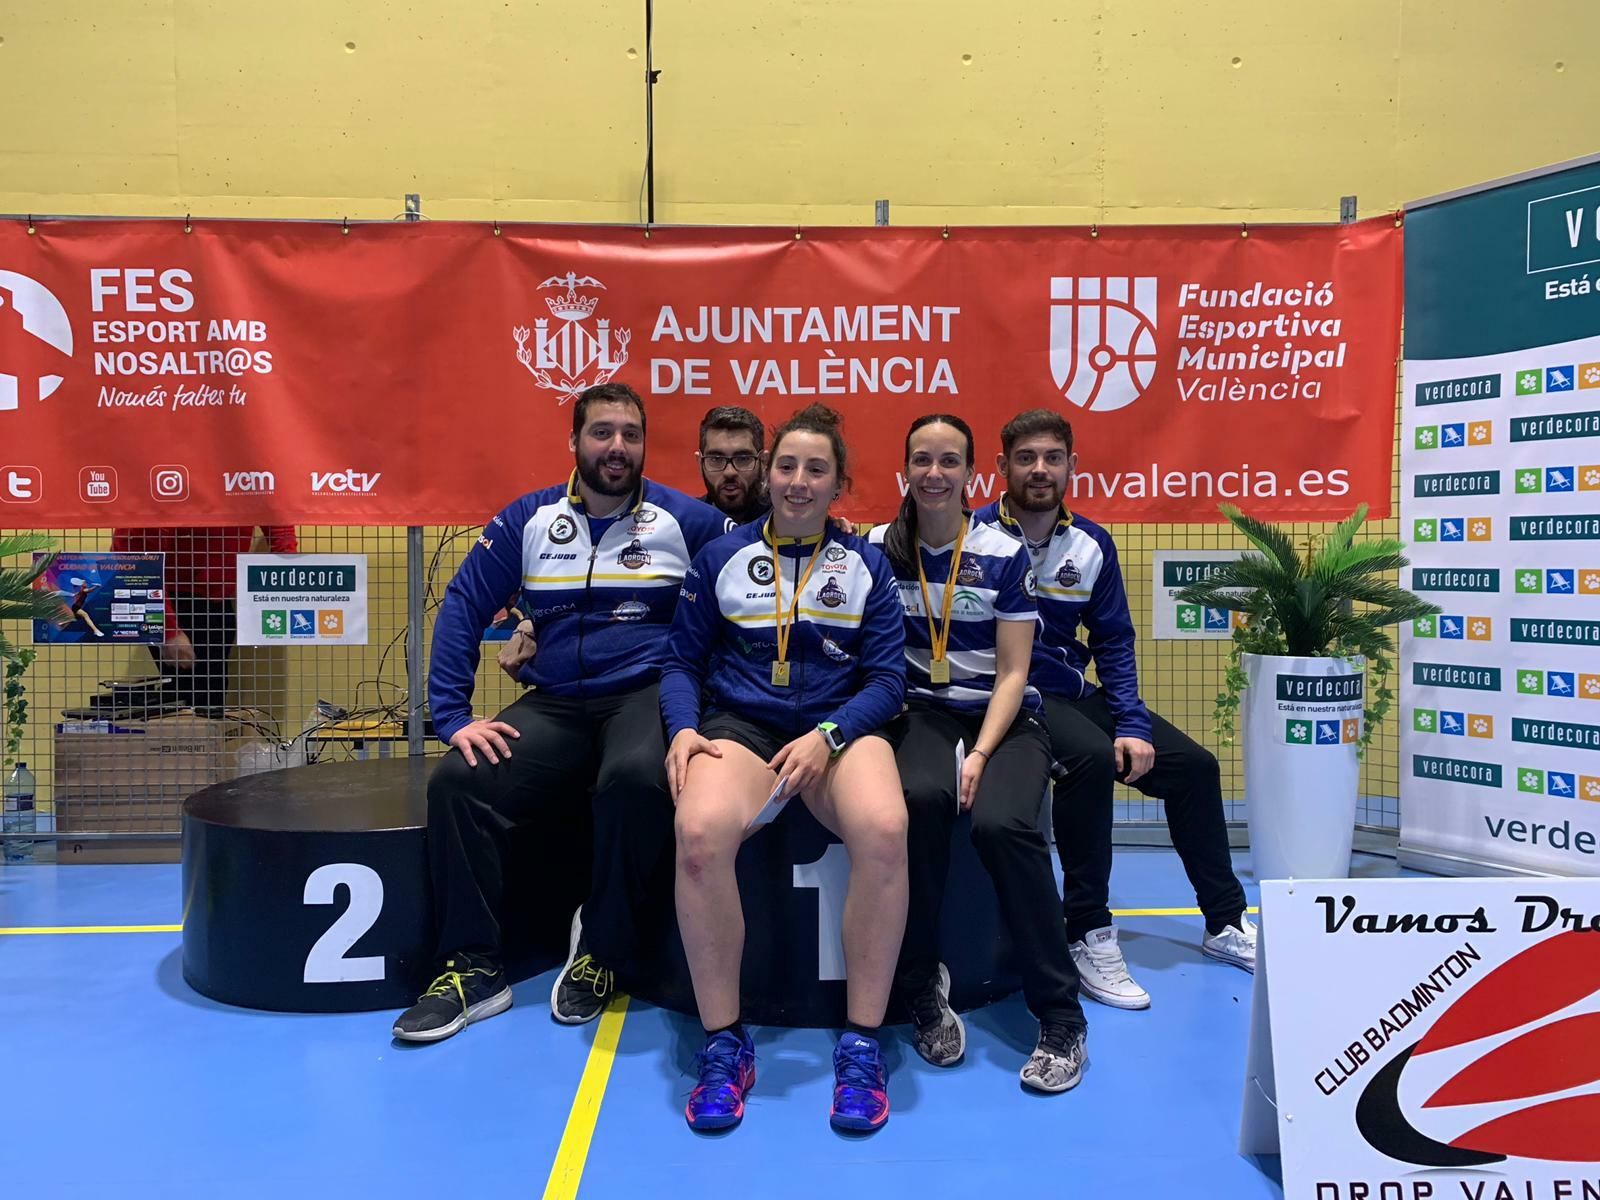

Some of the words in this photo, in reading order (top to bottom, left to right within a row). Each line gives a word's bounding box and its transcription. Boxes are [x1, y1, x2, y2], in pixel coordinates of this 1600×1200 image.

[91, 269, 194, 312] FES
[1178, 281, 1334, 308] Fundació
[1545, 274, 1590, 299] Está
[93, 321, 200, 343] ESPORT
[207, 320, 267, 341] AMB
[650, 305, 960, 343] AJUNTAMENT
[1178, 312, 1341, 346] Esportiva
[95, 348, 272, 376] NOSALTR@S
[1177, 342, 1347, 375] Municipal
[651, 358, 711, 395] DE
[729, 349, 959, 395] VALÈNCIA
[98, 385, 167, 407] Només
[172, 384, 224, 411] faltes
[229, 384, 246, 405] tu
[1177, 375, 1321, 401] València
[1425, 380, 1491, 400] verdecora
[1521, 417, 1600, 436] verdecora
[90, 471, 105, 481] You
[1424, 476, 1490, 492] verdecora
[89, 484, 109, 494] Tube
[1521, 518, 1600, 535] verdecora
[260, 568, 344, 586] verdecora
[957, 568, 984, 580] AORDEN
[1422, 571, 1489, 587] verdecora
[253, 594, 269, 602] Está
[311, 594, 350, 602] naturaleza
[1522, 622, 1600, 640] verdecora
[1423, 667, 1490, 685] verdecora
[1286, 679, 1360, 697] verdecora
[1278, 703, 1294, 711] Está
[1523, 724, 1600, 745] verdecora
[1423, 760, 1492, 781] verdecora
[1485, 815, 1600, 854] verde
[793, 843, 855, 980] 1
[1315, 895, 1497, 933] Vamos
[303, 863, 385, 983] 2
[1315, 1041, 1370, 1095] CLUB
[1363, 942, 1481, 1051] BADMINTON
[1316, 1181, 1433, 1200] DROP
